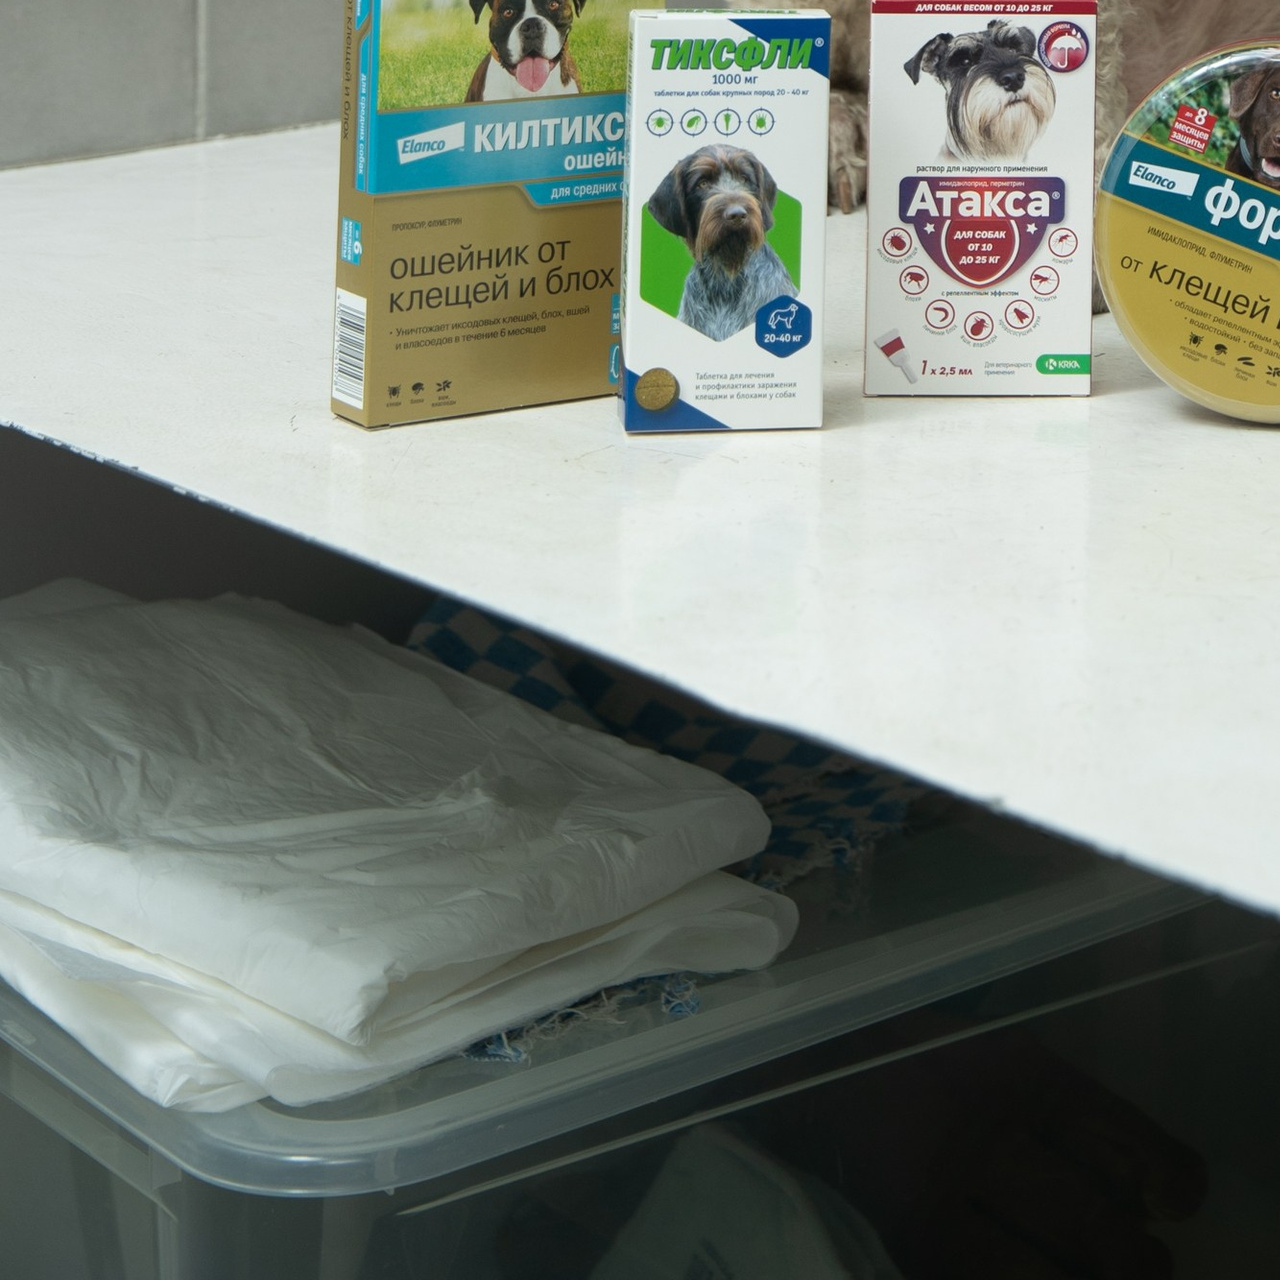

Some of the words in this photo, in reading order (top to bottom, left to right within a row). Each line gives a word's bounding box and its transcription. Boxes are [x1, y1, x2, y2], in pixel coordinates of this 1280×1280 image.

[915, 4, 933, 13] ДЛЯ
[934, 4, 962, 12] СОБАК
[963, 4, 993, 12] ВЕСОМ
[994, 4, 1005, 12] ОТ
[1006, 4, 1016, 12] 10
[1017, 4, 1030, 13] ДО
[1030, 4, 1042, 12] 25
[1042, 4, 1053, 12] КГ
[650, 37, 813, 71] ТИКСФЛИ
[712, 74, 741, 85] 1000
[744, 75, 758, 85] мг
[687, 90, 699, 98] для
[722, 89, 752, 99] крупных
[754, 89, 775, 98] пород
[1194, 108, 1208, 125] 8
[1174, 122, 1209, 140] месяцев
[401, 138, 446, 154] Elanco
[1171, 132, 1205, 150] защиты
[564, 147, 629, 171] ошейн
[1132, 164, 1176, 190] Elanco
[551, 187, 570, 200] для
[573, 181, 617, 198] средних
[906, 180, 1050, 217] Атакса
[954, 231, 978, 240] ДЛЯ
[979, 231, 1006, 239] СОБАК
[968, 243, 980, 251] ОТ
[981, 243, 993, 251] 10
[390, 244, 529, 280] ошейник
[538, 240, 571, 263] от
[959, 256, 974, 264] ДО
[975, 256, 987, 264] 25
[988, 256, 1001, 264] КГ
[1209, 251, 1253, 274] ФЛУМЕТРИН
[389, 274, 509, 313] клещей
[519, 277, 536, 298] и
[546, 266, 615, 294] блох
[1120, 255, 1143, 273] от
[1149, 260, 1271, 324] клещей
[395, 323, 450, 337] Уничтожает
[451, 317, 501, 330] иксодовых
[502, 312, 540, 325] клещей,
[541, 309, 564, 320] блох,
[566, 306, 590, 316] вшей
[1174, 300, 1212, 320] обладает
[1213, 315, 1272, 344] репеллентным
[403, 336, 453, 350] власоедов
[454, 335, 460, 343] в
[462, 331, 499, 342] течение
[500, 328, 506, 337] 6
[507, 325, 546, 337] месяцев
[764, 334, 791, 343] 20-40
[792, 334, 802, 342] кг
[1189, 318, 1241, 343] водостойкий
[1248, 341, 1263, 354] без
[921, 359, 928, 375] 1
[939, 366, 955, 376] 2,5
[959, 367, 973, 375] мл
[1058, 360, 1080, 369] KRKA
[696, 372, 728, 380] Таблетка
[730, 373, 742, 381] для
[702, 382, 755, 392] профилактики
[757, 382, 797, 390] заражения
[695, 393, 728, 401] клещами
